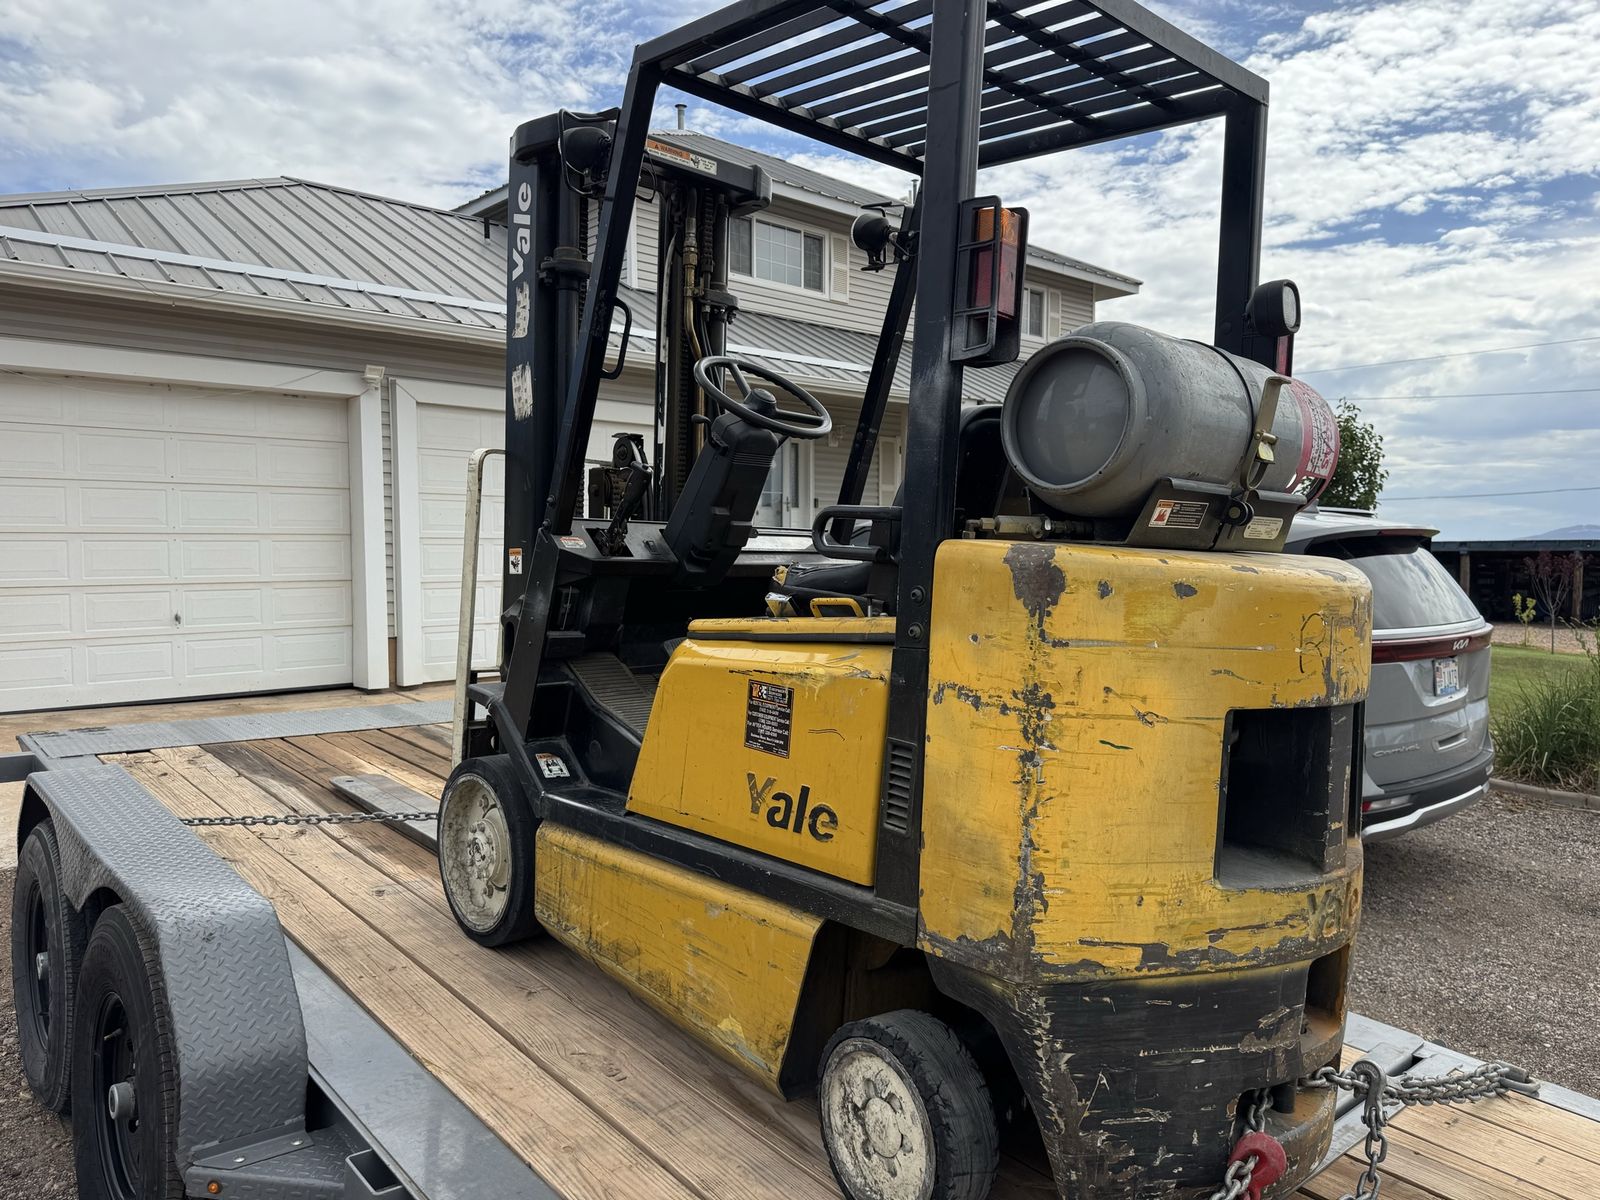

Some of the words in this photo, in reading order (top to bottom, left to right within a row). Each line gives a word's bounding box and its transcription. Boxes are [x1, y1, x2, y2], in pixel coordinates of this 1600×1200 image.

[512, 182, 532, 282] Yale
[1453, 638, 1469, 651] KIA
[746, 771, 839, 843] Yale
